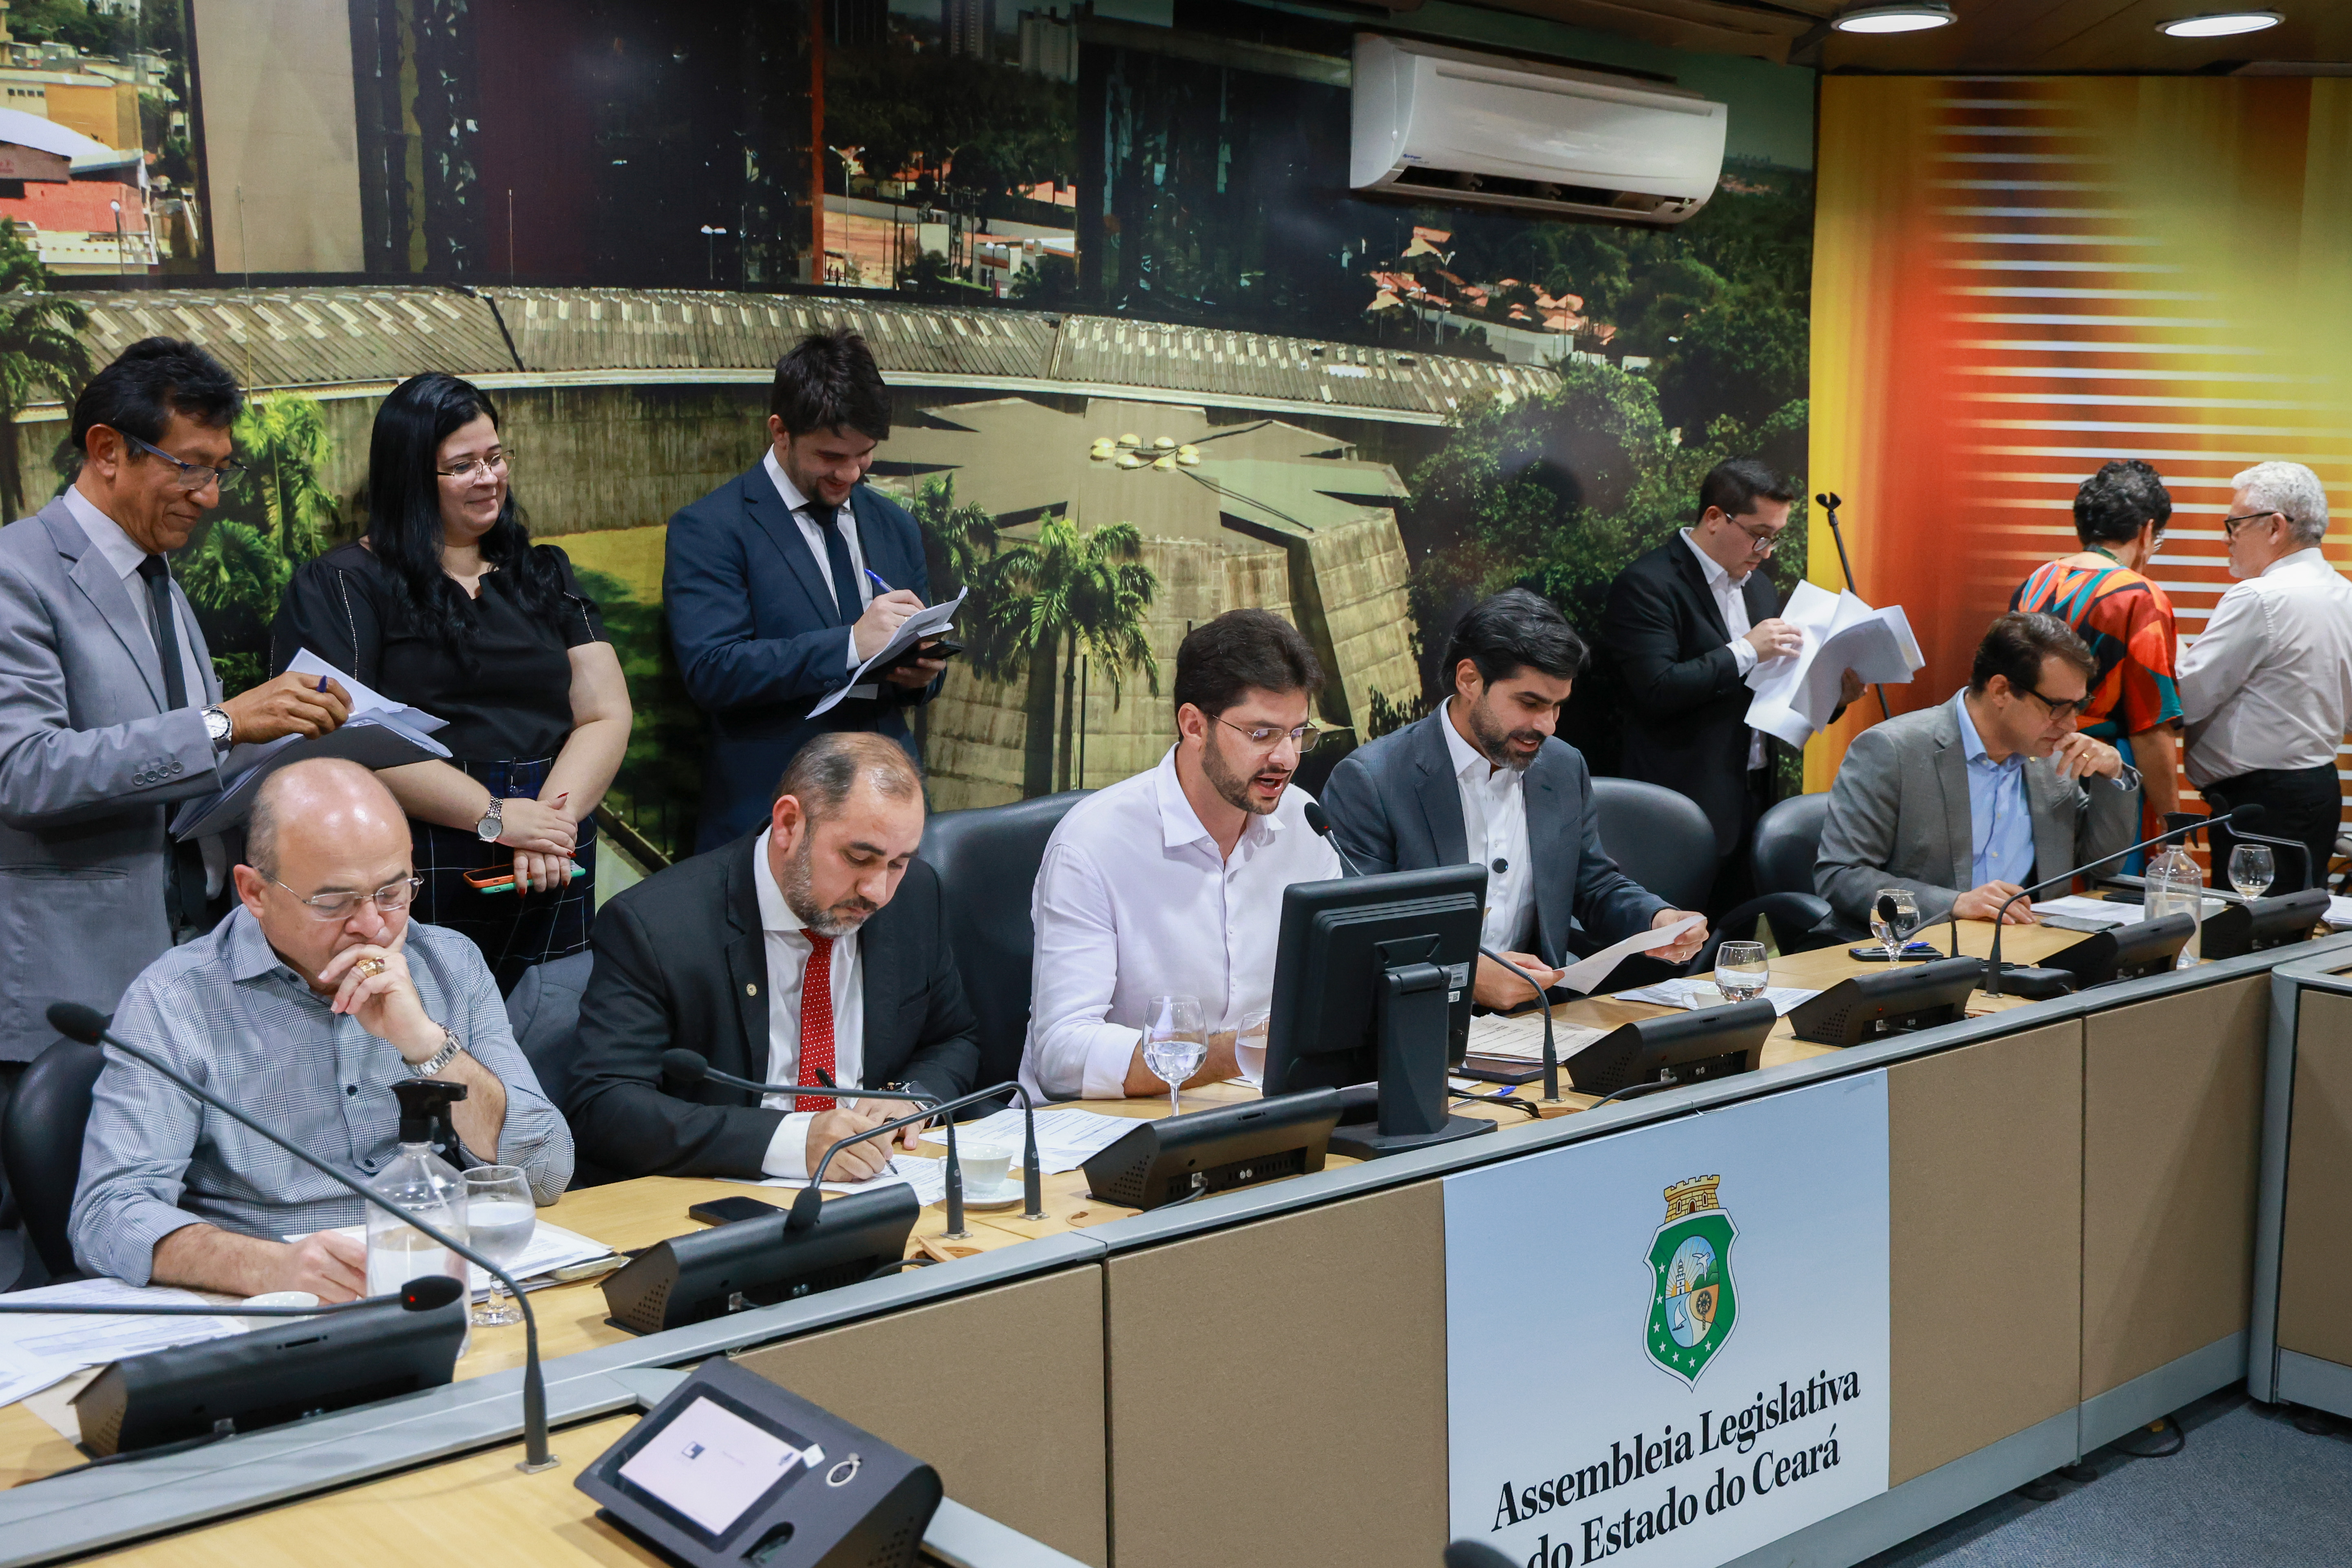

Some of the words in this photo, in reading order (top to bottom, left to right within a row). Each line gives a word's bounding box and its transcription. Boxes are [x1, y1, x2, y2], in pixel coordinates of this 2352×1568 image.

[1491, 1425, 1695, 1532] Assembleia
[1699, 1369, 1861, 1455] Legislativa
[1527, 1533, 1573, 1568] do
[1580, 1486, 1698, 1566] Estado
[1705, 1467, 1745, 1515] do
[1753, 1423, 1840, 1495] Ceará
